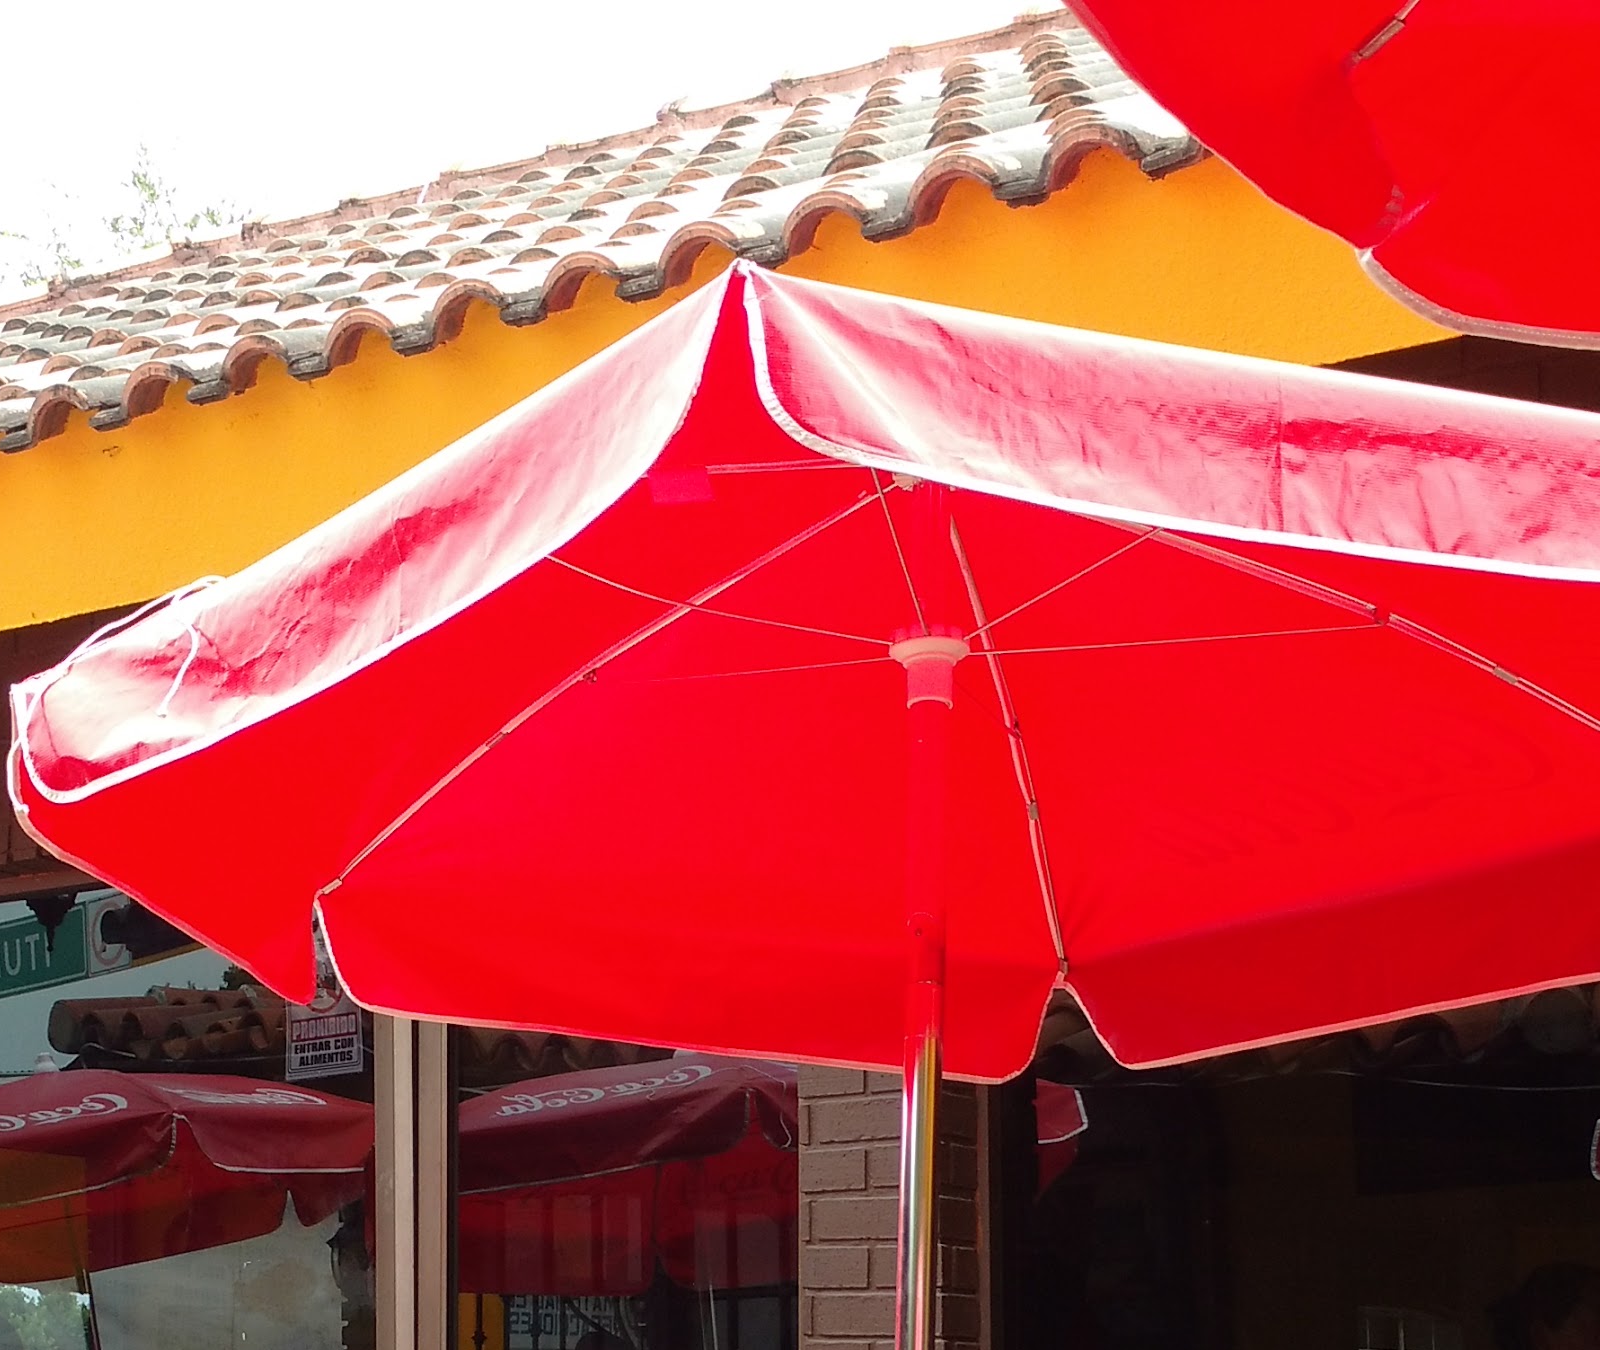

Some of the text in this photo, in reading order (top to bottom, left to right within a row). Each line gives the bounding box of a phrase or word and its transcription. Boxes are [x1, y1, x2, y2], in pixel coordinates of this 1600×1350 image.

[292, 1013, 356, 1040] PROHIBIDO
[294, 1037, 354, 1055] ENTRAR CON
[299, 1050, 353, 1067] ALIMENTOS
